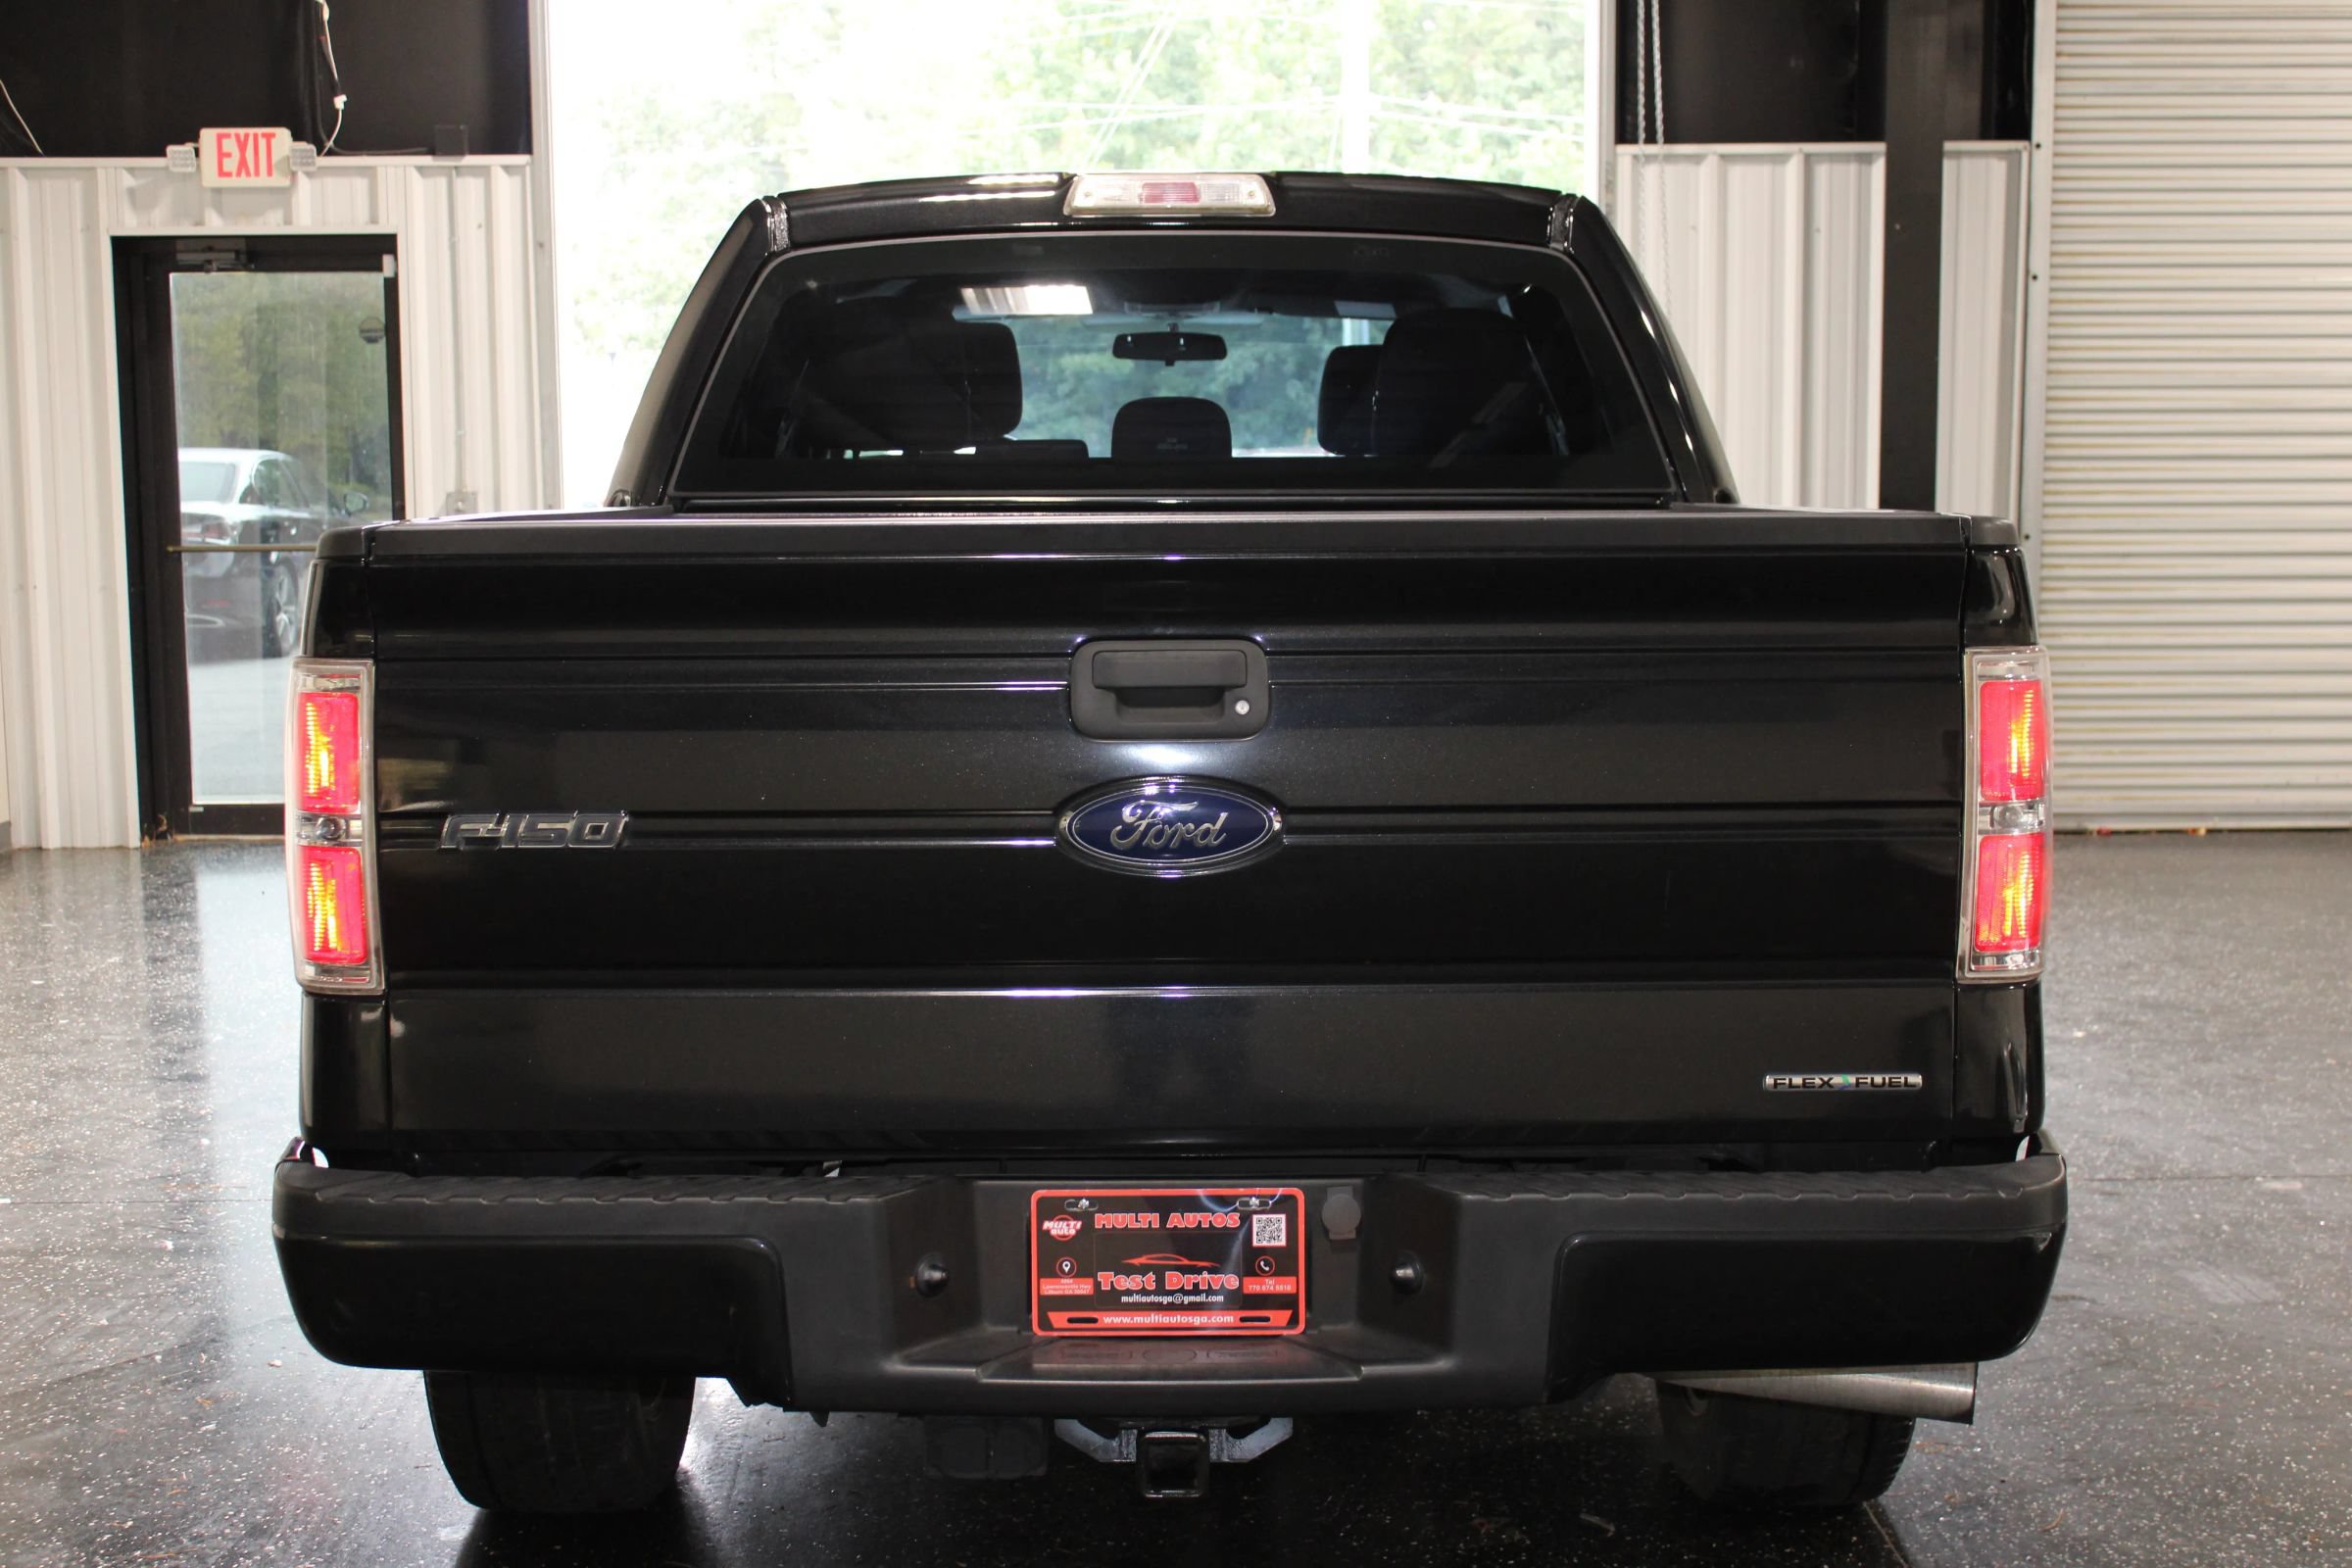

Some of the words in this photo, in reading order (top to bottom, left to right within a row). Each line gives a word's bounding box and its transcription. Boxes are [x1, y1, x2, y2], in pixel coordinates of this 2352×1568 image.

[216, 132, 276, 178] EXIT
[441, 812, 629, 850] F-150
[1110, 800, 1229, 850] Ford
[1772, 1077, 1836, 1090] FLEX
[1855, 1076, 1917, 1089] FUEL
[1042, 1220, 1083, 1231] MULTI
[1095, 1212, 1160, 1229] MULTI
[1165, 1212, 1241, 1229] AUTOS
[1098, 1271, 1156, 1291] Test
[1164, 1270, 1240, 1291] Drive
[1120, 1293, 1224, 1305] multiautosga@gmail.com
[1102, 1314, 1234, 1326] www.multiautosga.com
